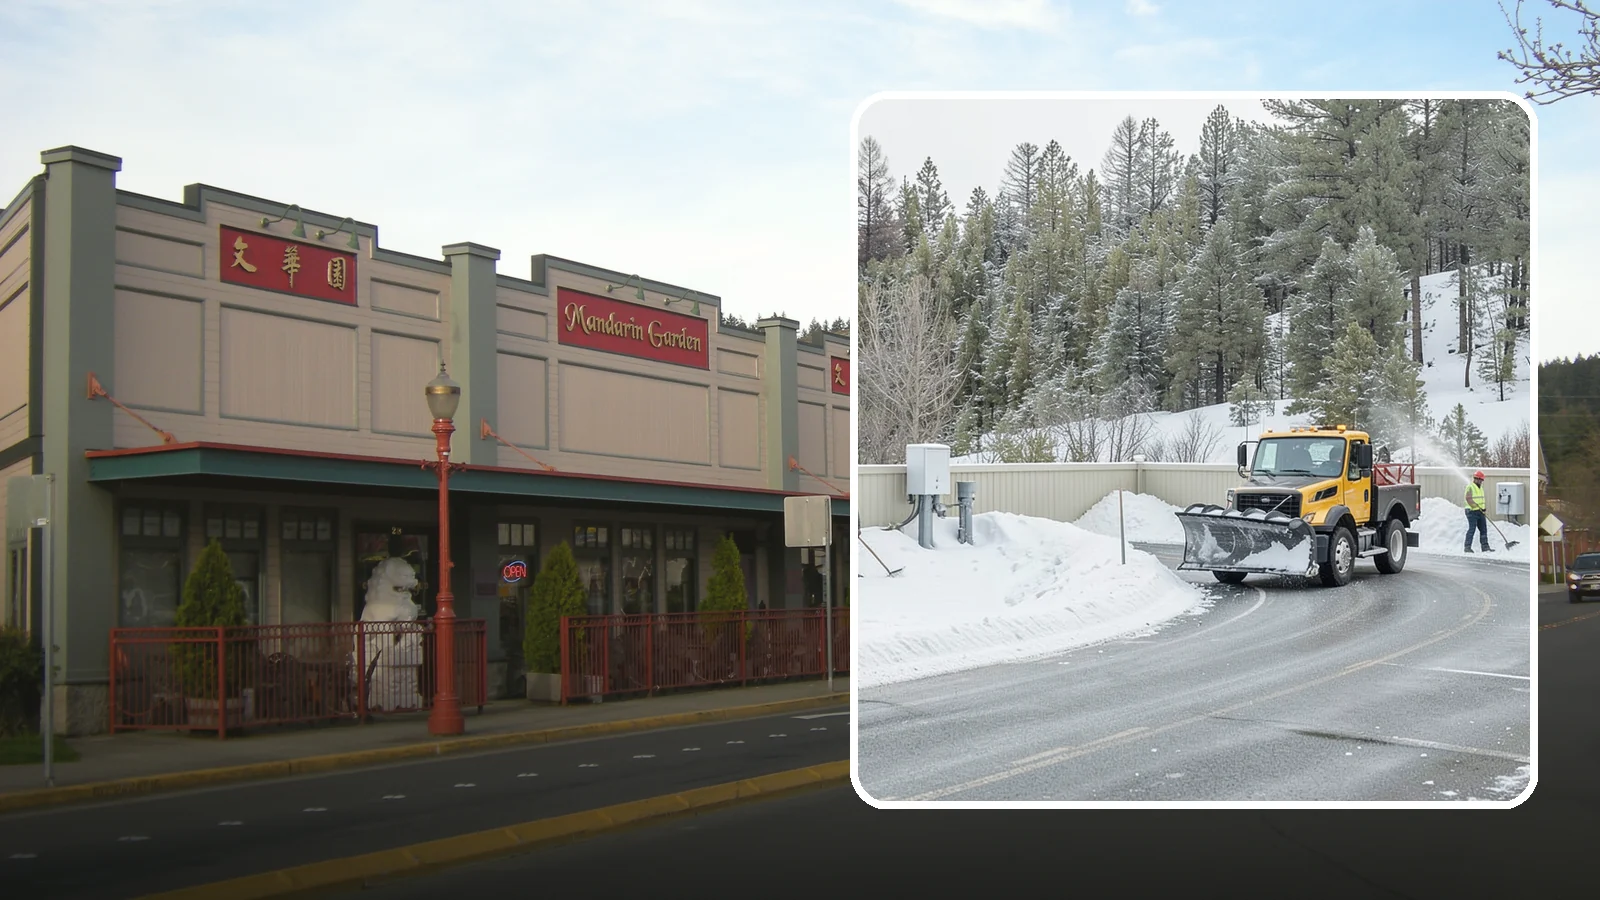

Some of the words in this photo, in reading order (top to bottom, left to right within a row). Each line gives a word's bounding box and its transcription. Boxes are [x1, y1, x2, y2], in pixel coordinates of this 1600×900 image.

[231, 236, 346, 291] 文華園
[565, 302, 644, 341] Mandarin
[648, 320, 701, 352] Garden
[503, 565, 527, 578] OPEN
